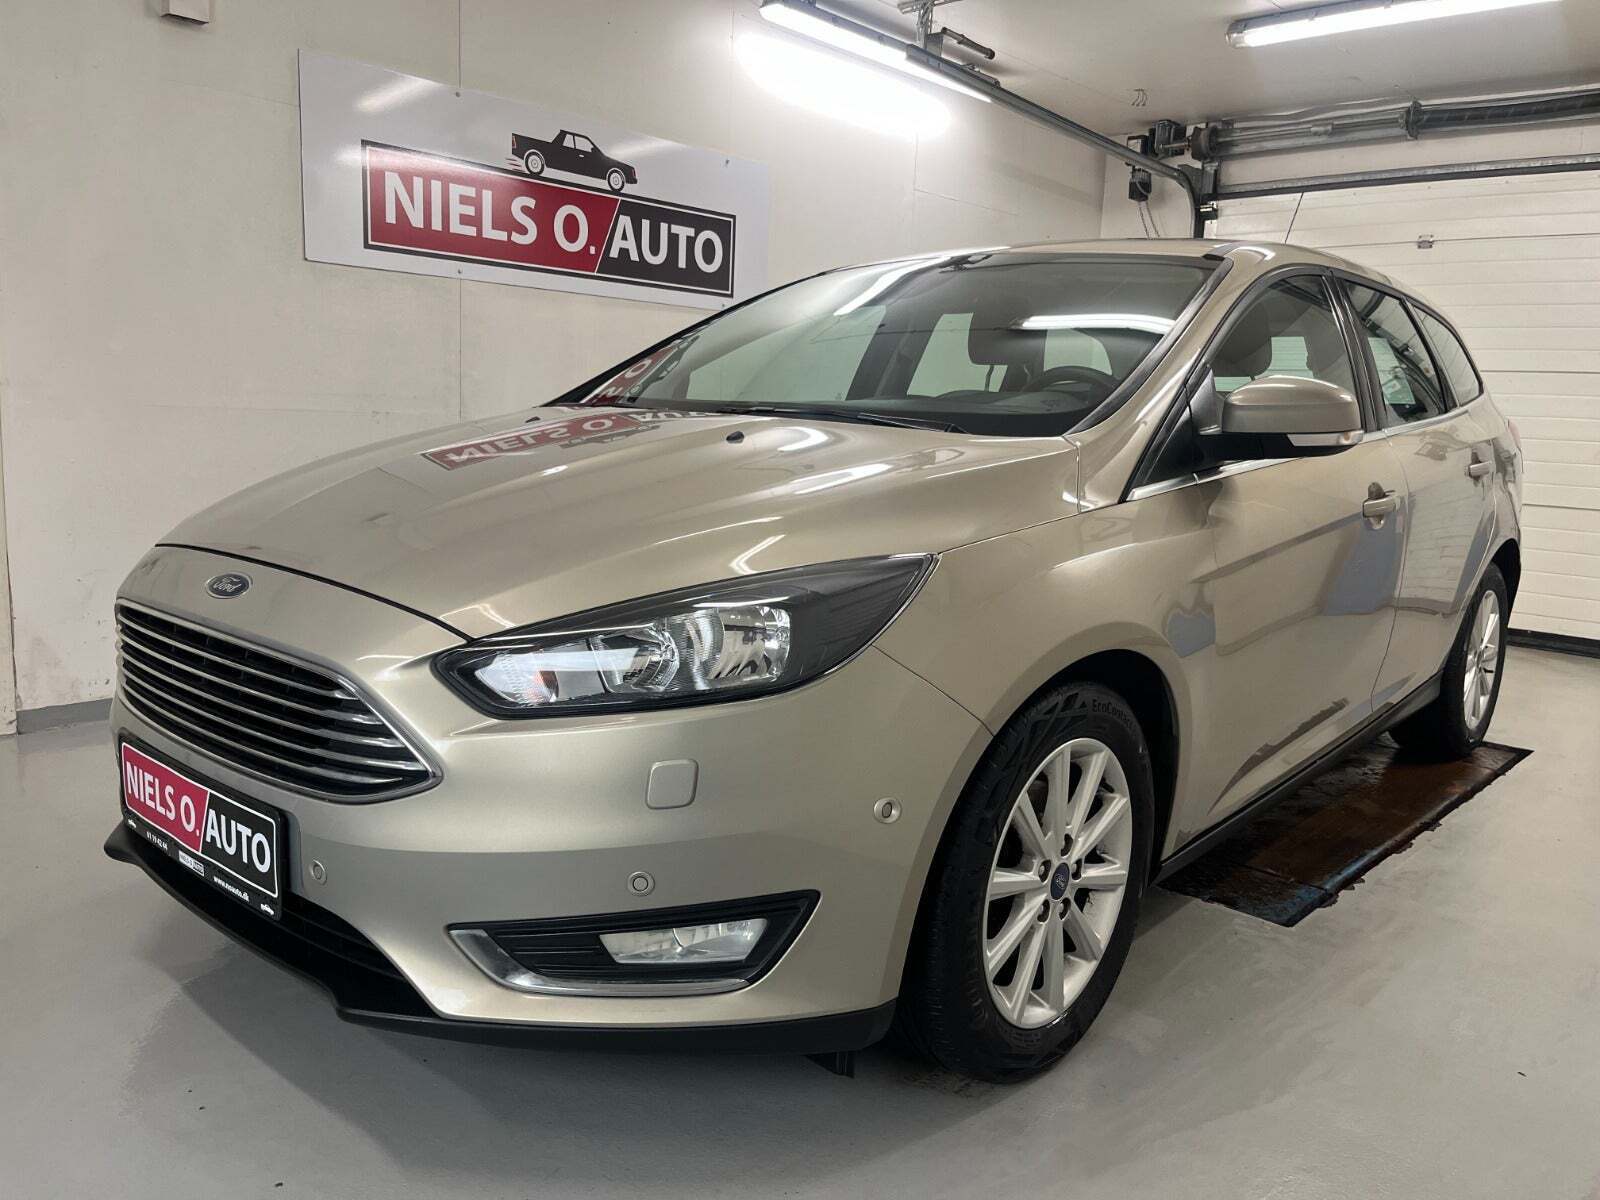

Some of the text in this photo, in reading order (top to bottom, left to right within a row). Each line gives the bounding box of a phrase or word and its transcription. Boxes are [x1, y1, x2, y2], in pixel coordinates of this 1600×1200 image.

[385, 171, 723, 273] NIELS O. AUTO
[126, 761, 176, 821] NIELS
[180, 795, 200, 837] O.
[205, 808, 271, 873] AUTO
